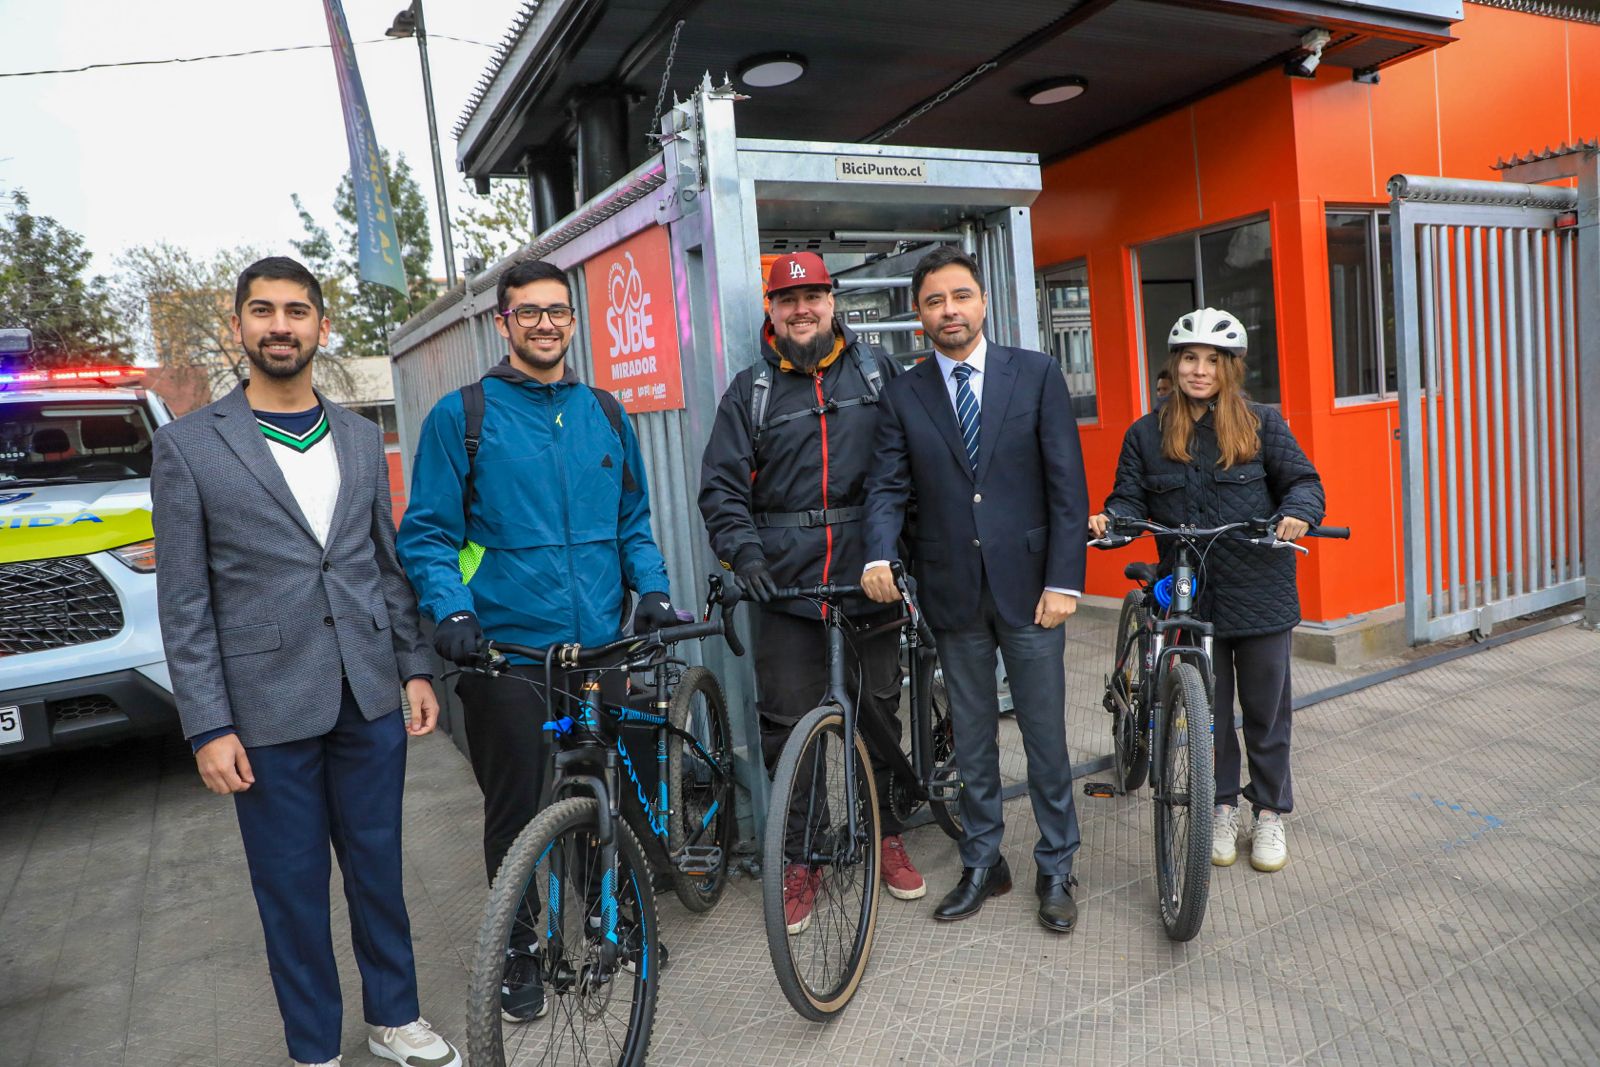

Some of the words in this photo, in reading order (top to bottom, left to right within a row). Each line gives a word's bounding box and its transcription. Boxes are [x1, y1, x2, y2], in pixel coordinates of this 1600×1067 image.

[842, 162, 922, 176] BiciPunto.cl
[789, 260, 806, 279] LA
[606, 293, 655, 358] SUBE
[611, 355, 657, 380] MIRADOR
